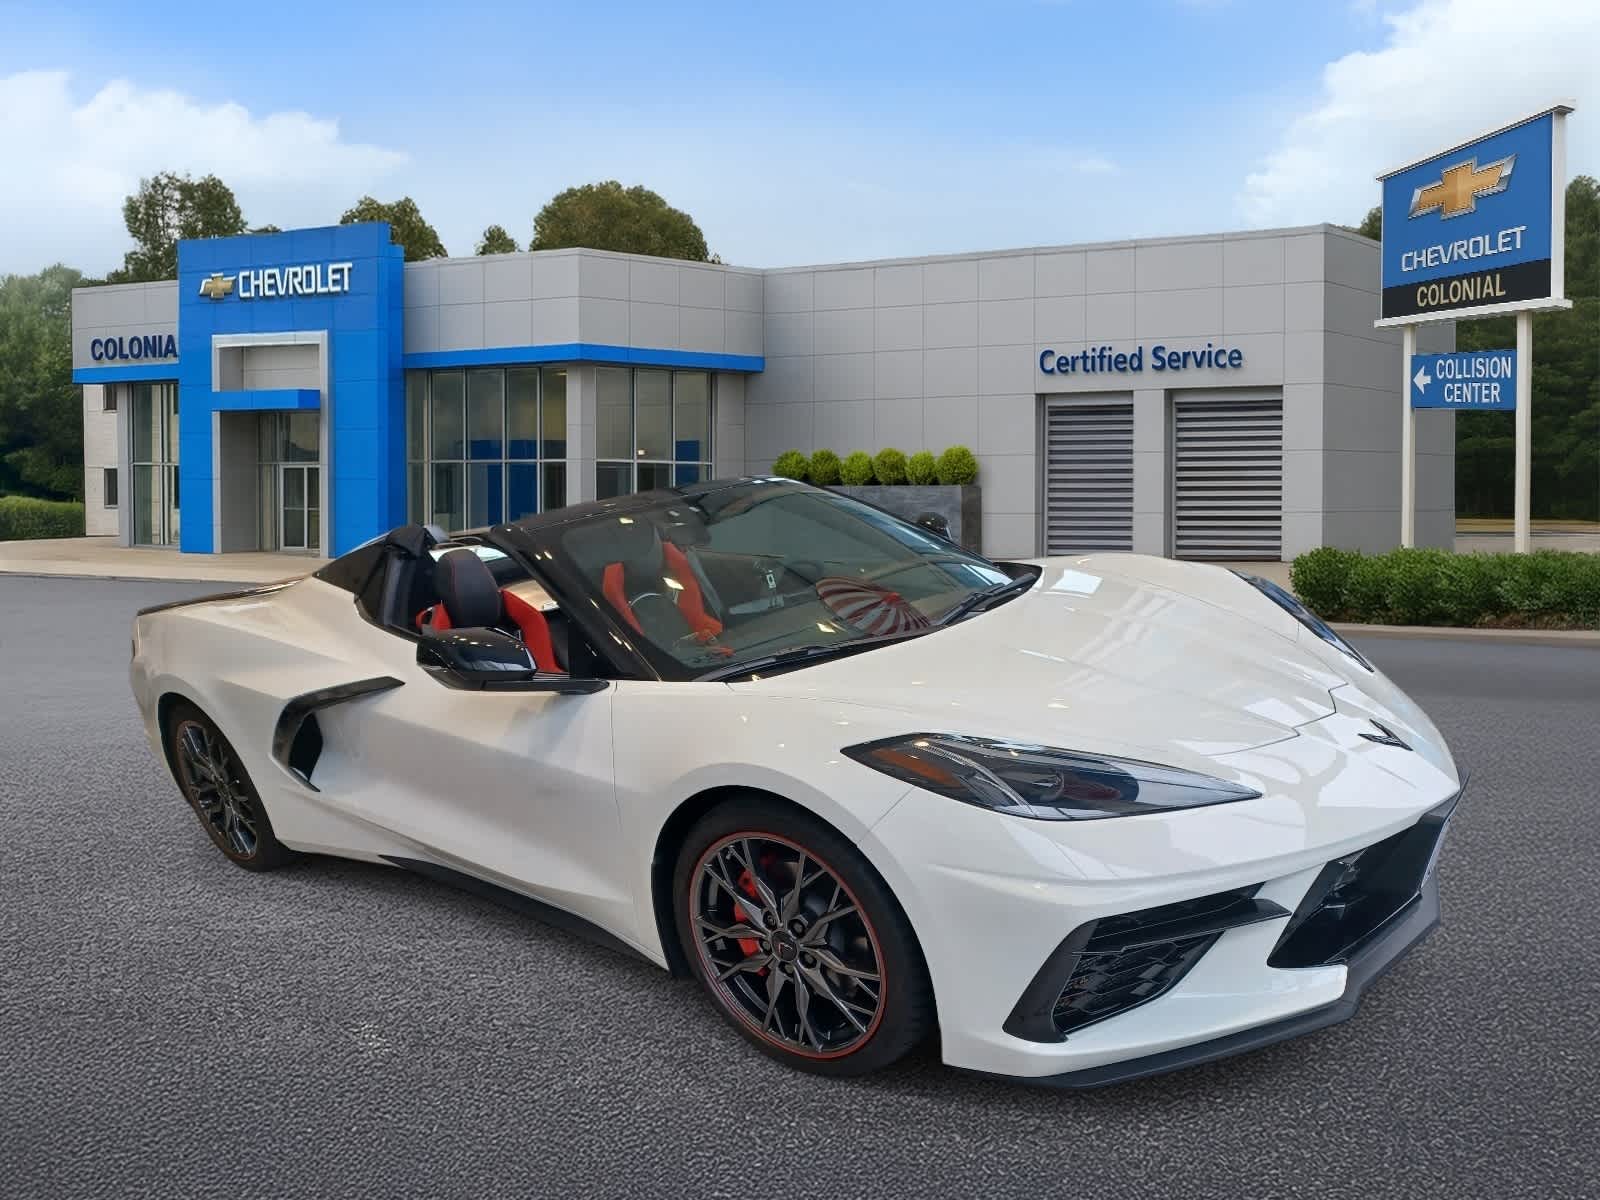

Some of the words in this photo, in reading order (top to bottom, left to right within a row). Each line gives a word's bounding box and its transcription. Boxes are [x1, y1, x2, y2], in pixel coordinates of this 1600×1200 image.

[1401, 226, 1526, 271] CHEVROLET
[239, 262, 353, 297] CHEVROLET
[1417, 274, 1506, 306] COLONIAL
[1039, 346, 1143, 375] Certified
[1151, 343, 1243, 371] Service
[1435, 356, 1512, 379] COLLISION
[1444, 382, 1501, 403] CENTER
